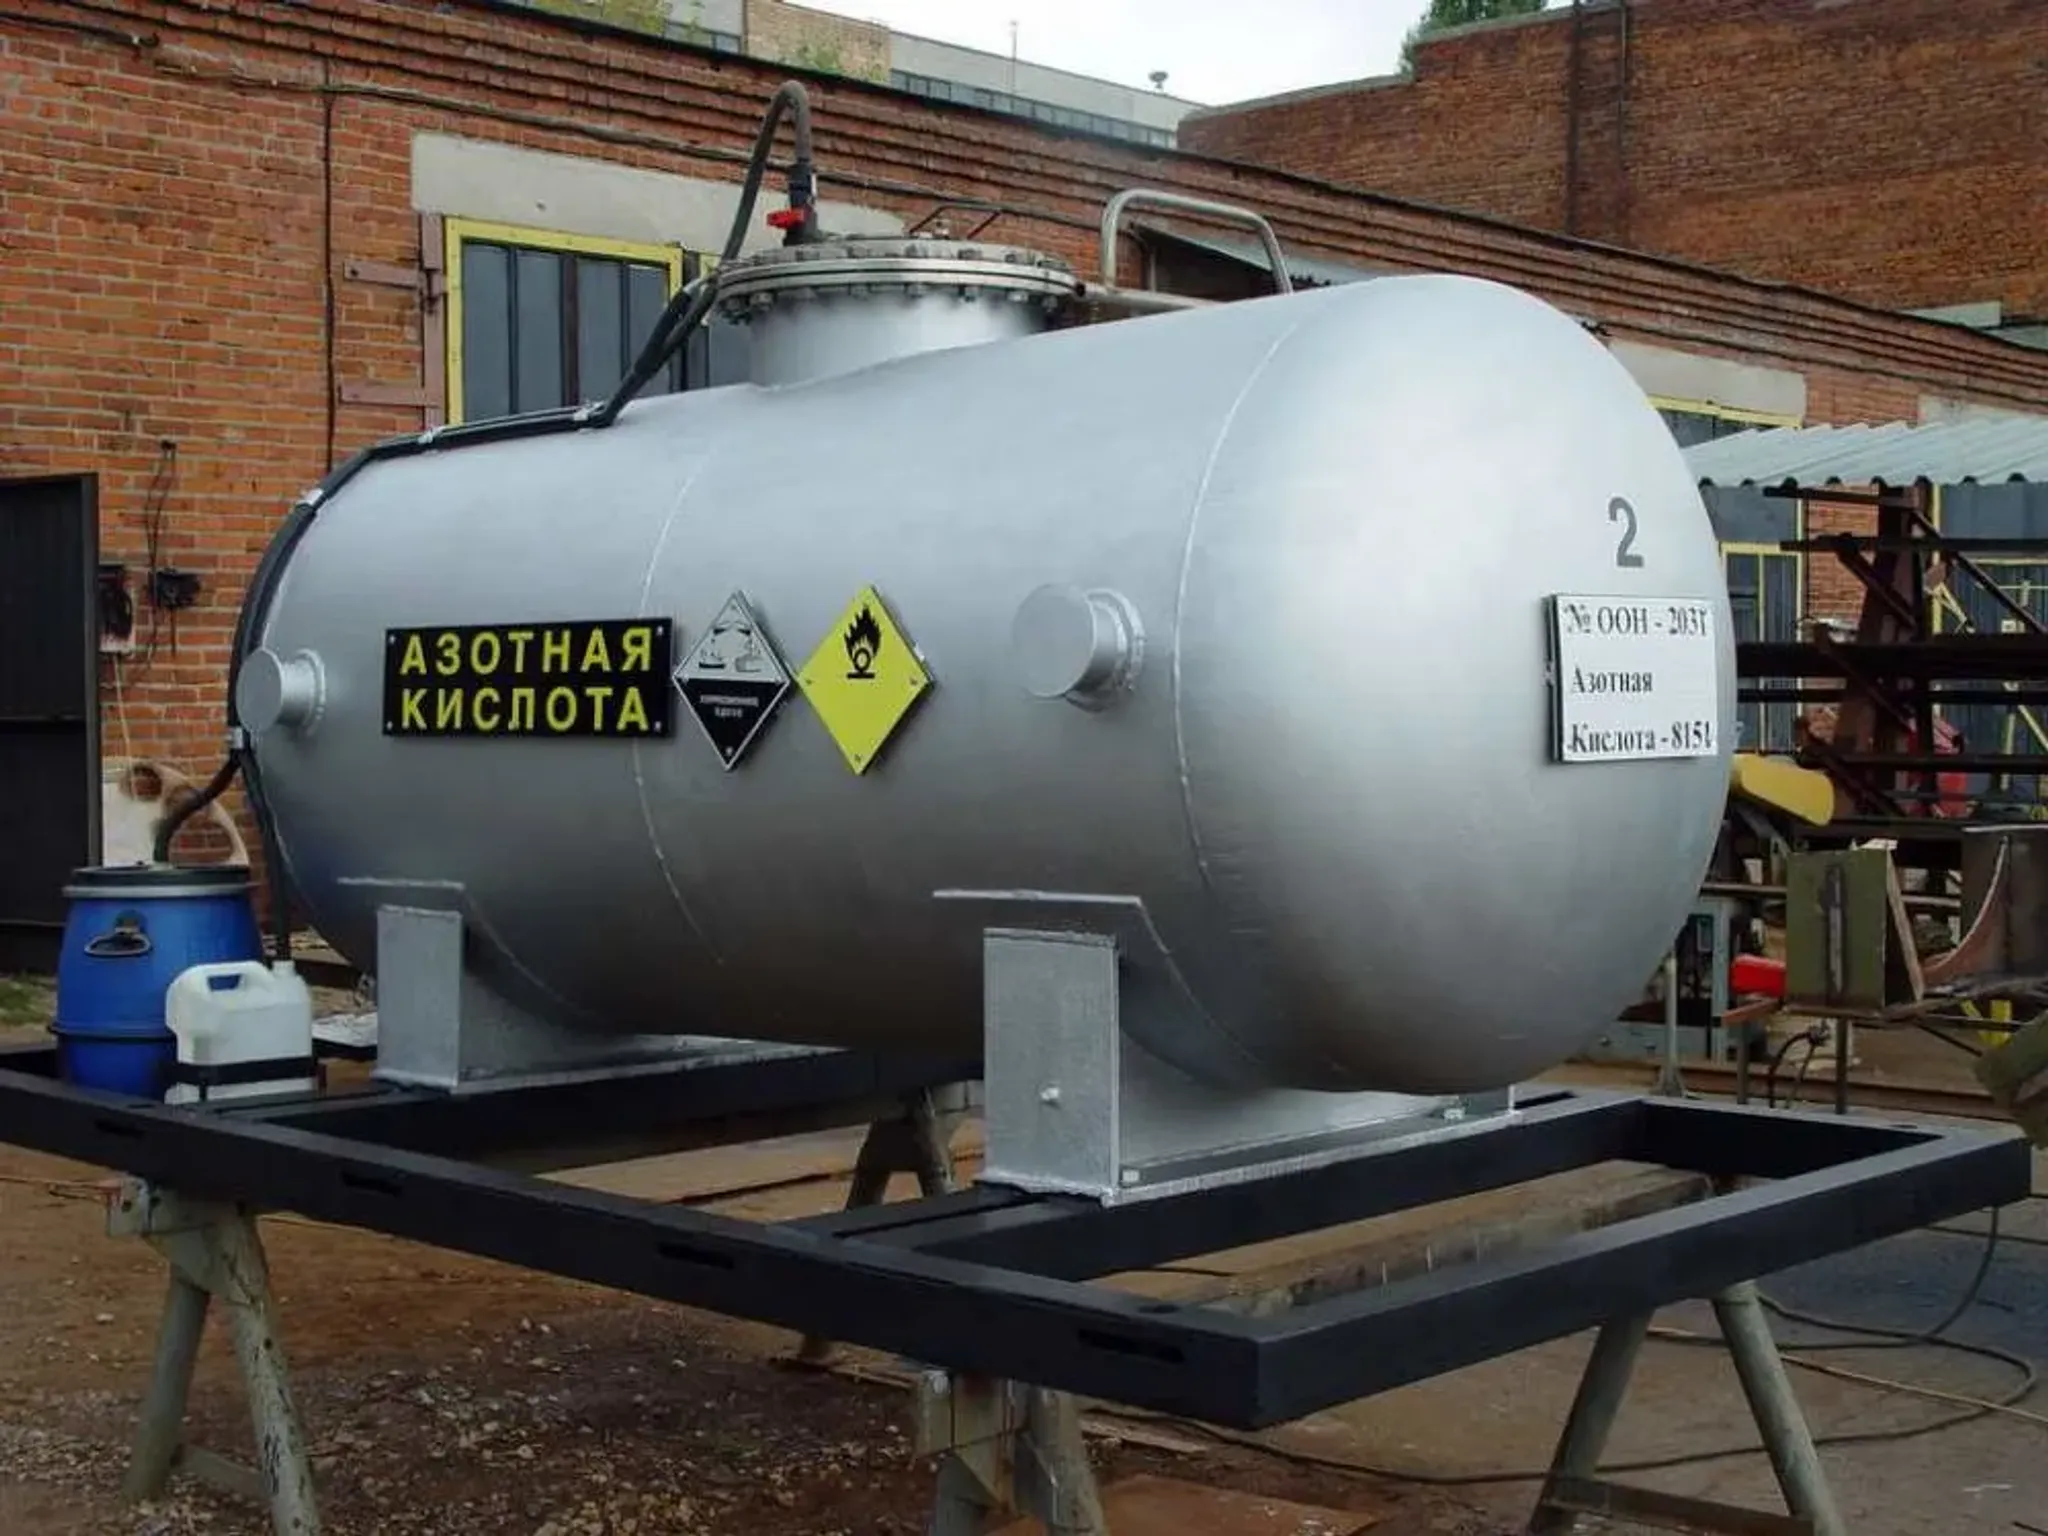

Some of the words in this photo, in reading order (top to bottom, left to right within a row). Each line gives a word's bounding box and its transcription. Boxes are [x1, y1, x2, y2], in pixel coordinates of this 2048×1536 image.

[1608, 496, 1645, 568] 2
[1564, 603, 1592, 634] №
[1597, 605, 1648, 635] ООН
[1668, 606, 1707, 637] 2031
[400, 626, 653, 676] АЗОТНАЯ
[1570, 665, 1653, 695] Азотная
[401, 685, 650, 732] КИСЛОТА
[1567, 722, 1656, 754] Кислота
